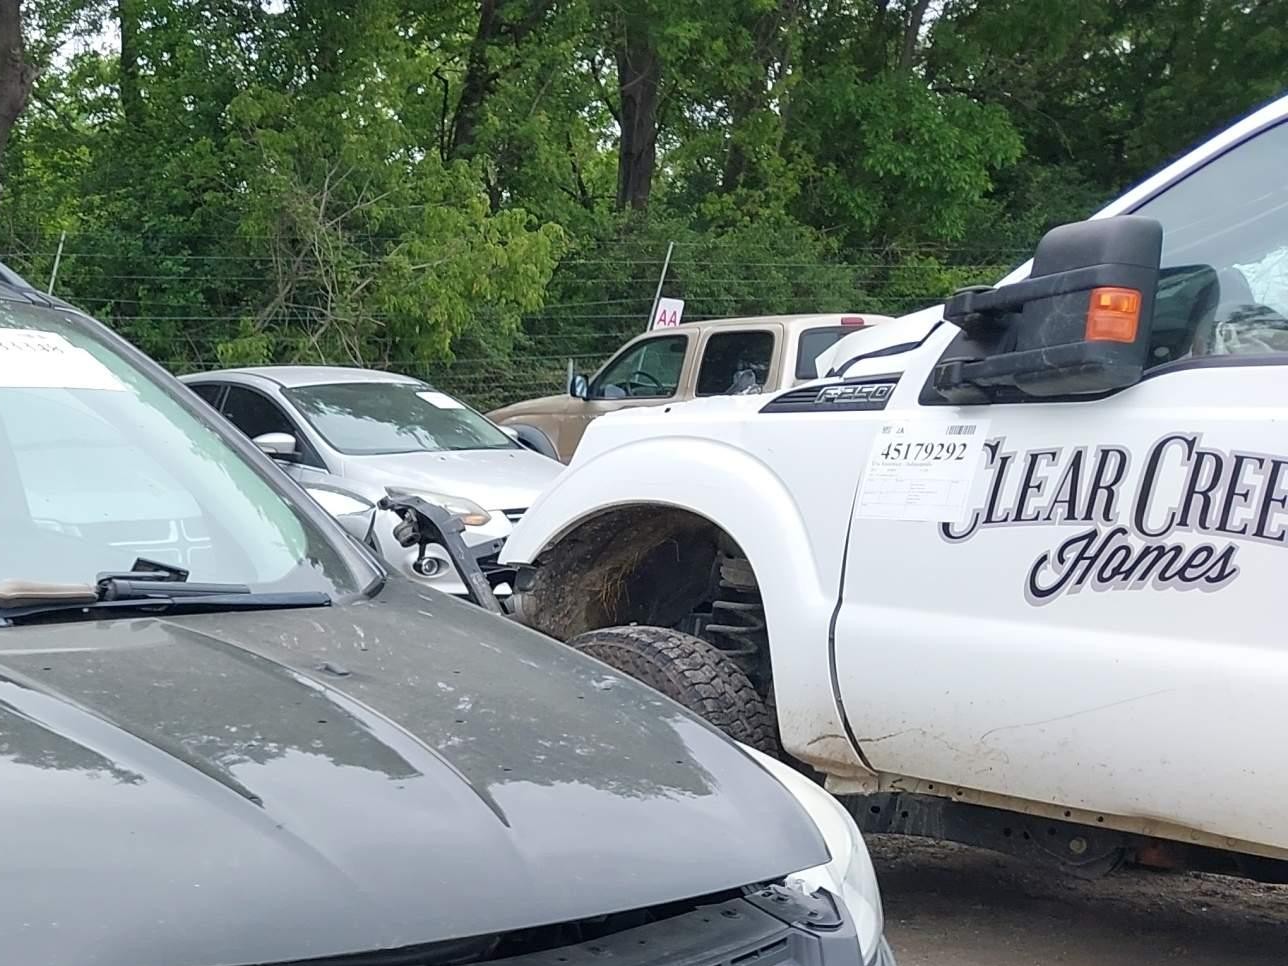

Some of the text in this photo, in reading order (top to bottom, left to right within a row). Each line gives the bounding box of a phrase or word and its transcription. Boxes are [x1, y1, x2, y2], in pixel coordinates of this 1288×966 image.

[657, 309, 677, 327] AA
[880, 442, 968, 461] 45179292
[1026, 525, 1241, 600] Homes
